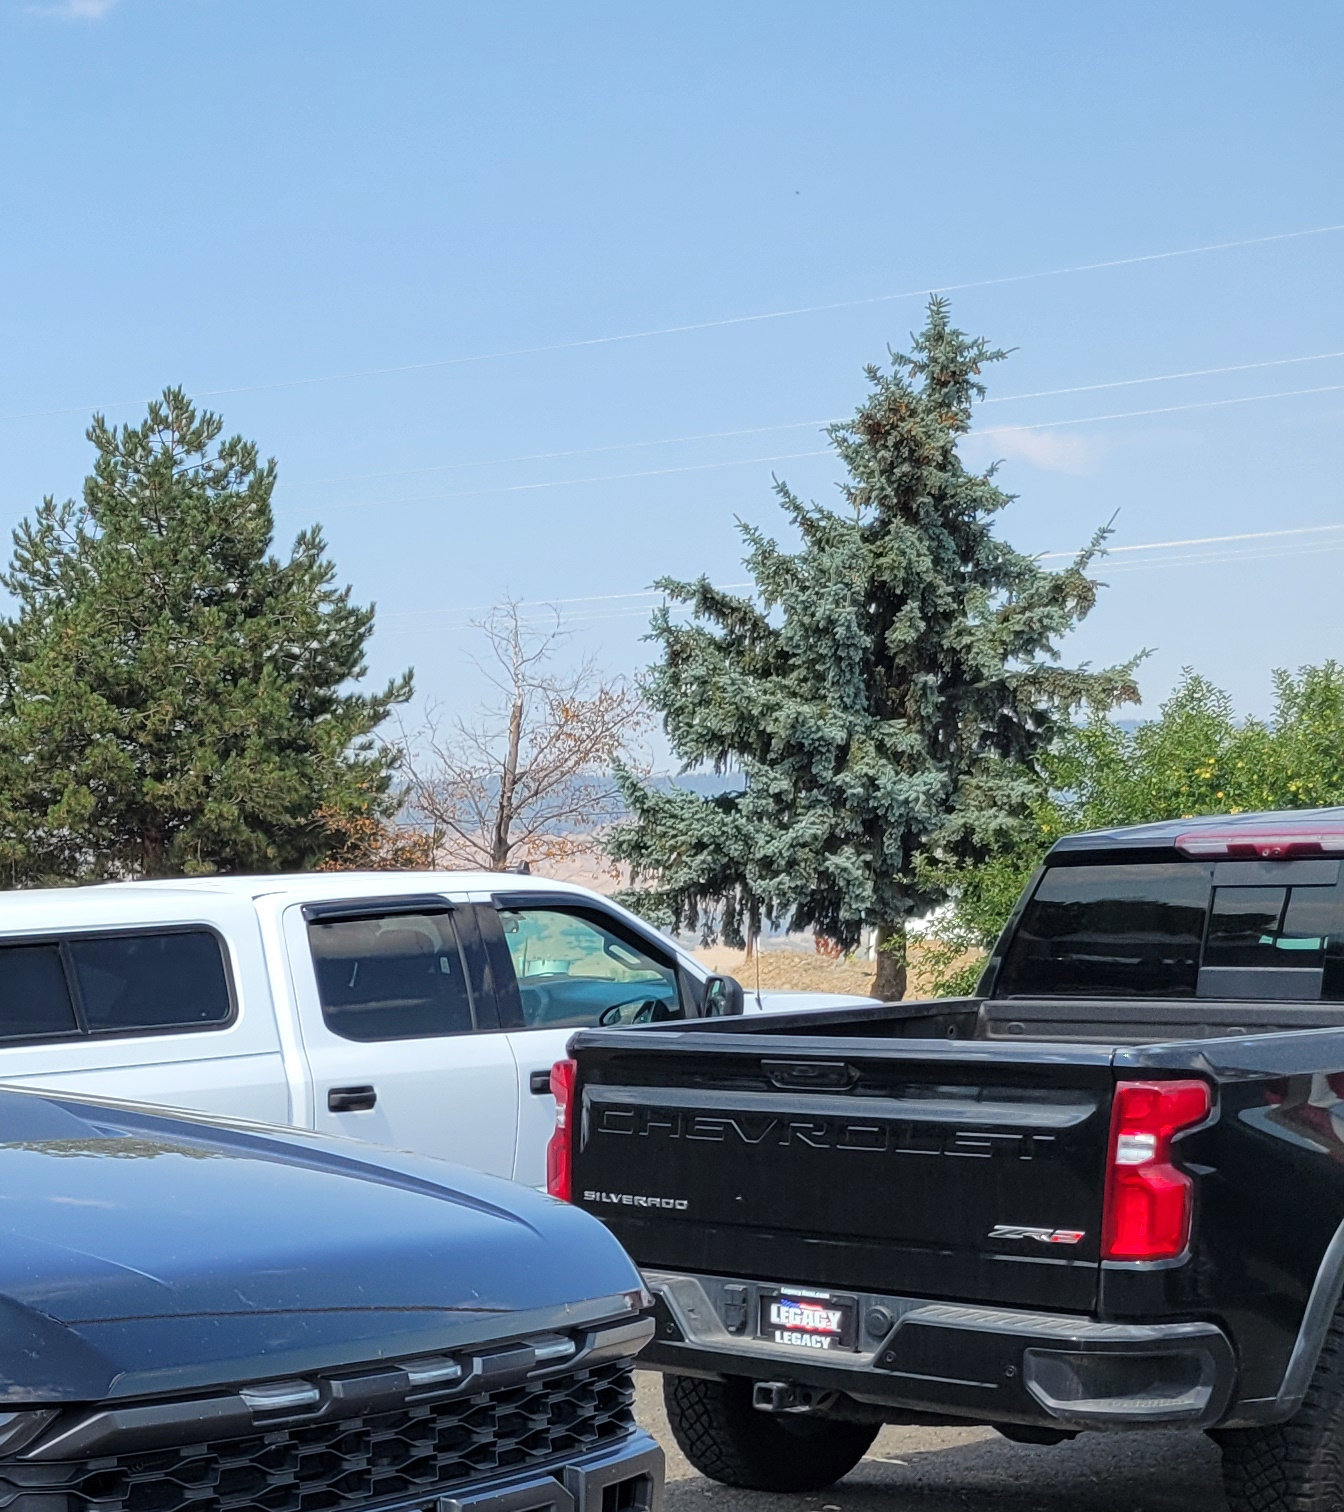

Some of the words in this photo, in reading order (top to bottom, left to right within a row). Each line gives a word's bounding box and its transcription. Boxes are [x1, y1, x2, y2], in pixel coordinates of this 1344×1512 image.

[597, 1109, 1057, 1161] CHEVROLET
[583, 1190, 689, 1211] SILVERADO
[770, 1303, 842, 1332] LEGACY
[774, 1330, 832, 1350] LEGACY
